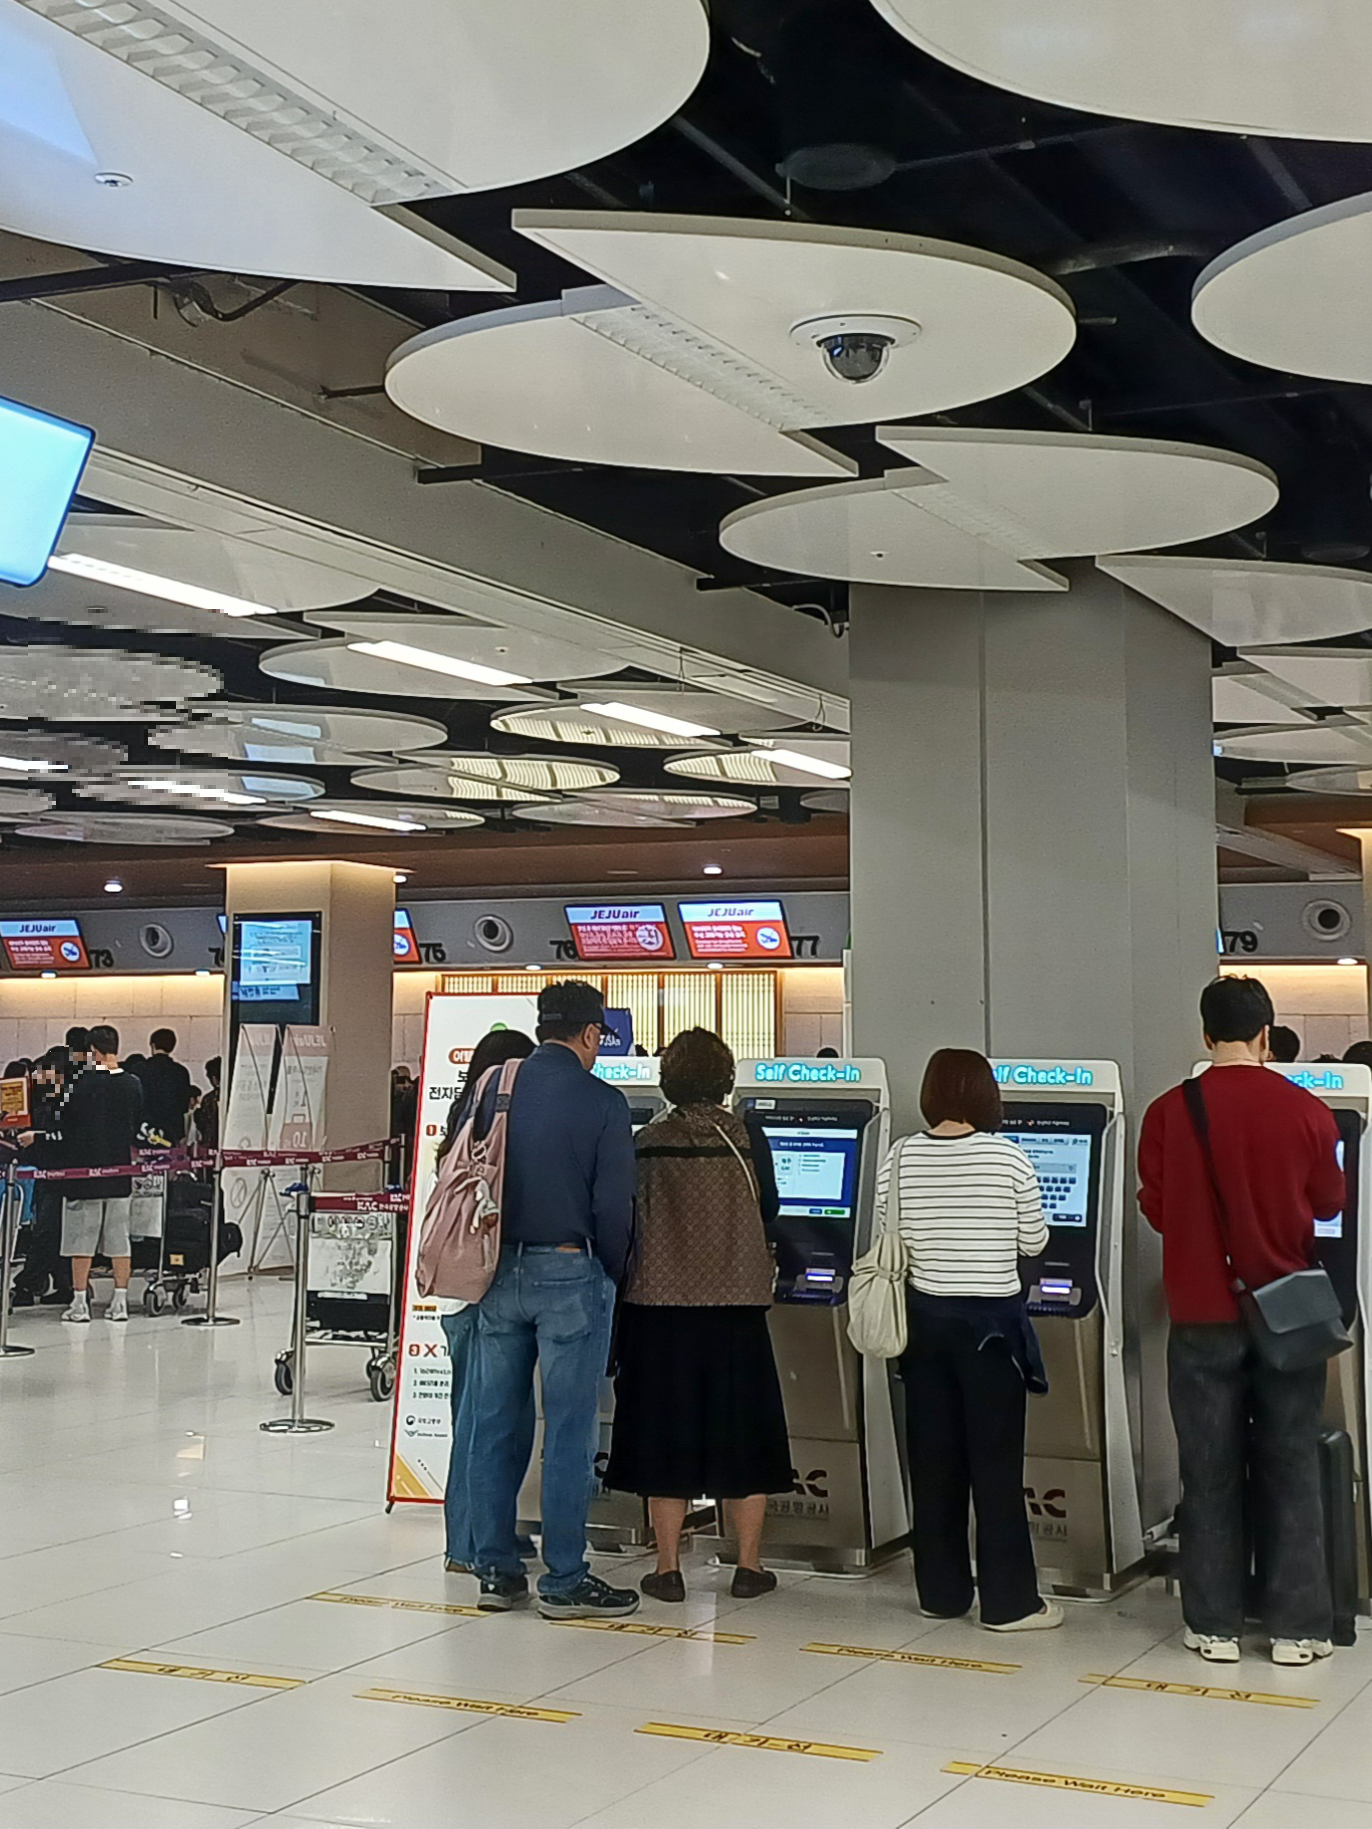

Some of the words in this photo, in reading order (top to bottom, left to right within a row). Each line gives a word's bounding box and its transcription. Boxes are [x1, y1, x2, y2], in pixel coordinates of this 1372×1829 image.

[590, 909, 640, 920] JEJUair
[707, 908, 755, 917] JEJUair
[19, 924, 56, 933] JEJUair
[549, 940, 577, 959] 76
[789, 935, 820, 956] 77
[1222, 930, 1258, 952] 79
[418, 942, 446, 963] 75
[754, 1064, 786, 1081] Self
[786, 1064, 861, 1083] Check-In
[1013, 1066, 1093, 1086] Check-In
[984, 1768, 1056, 1783] Please
[1063, 1778, 1108, 1792] Wait
[1113, 1785, 1166, 1798] Here
